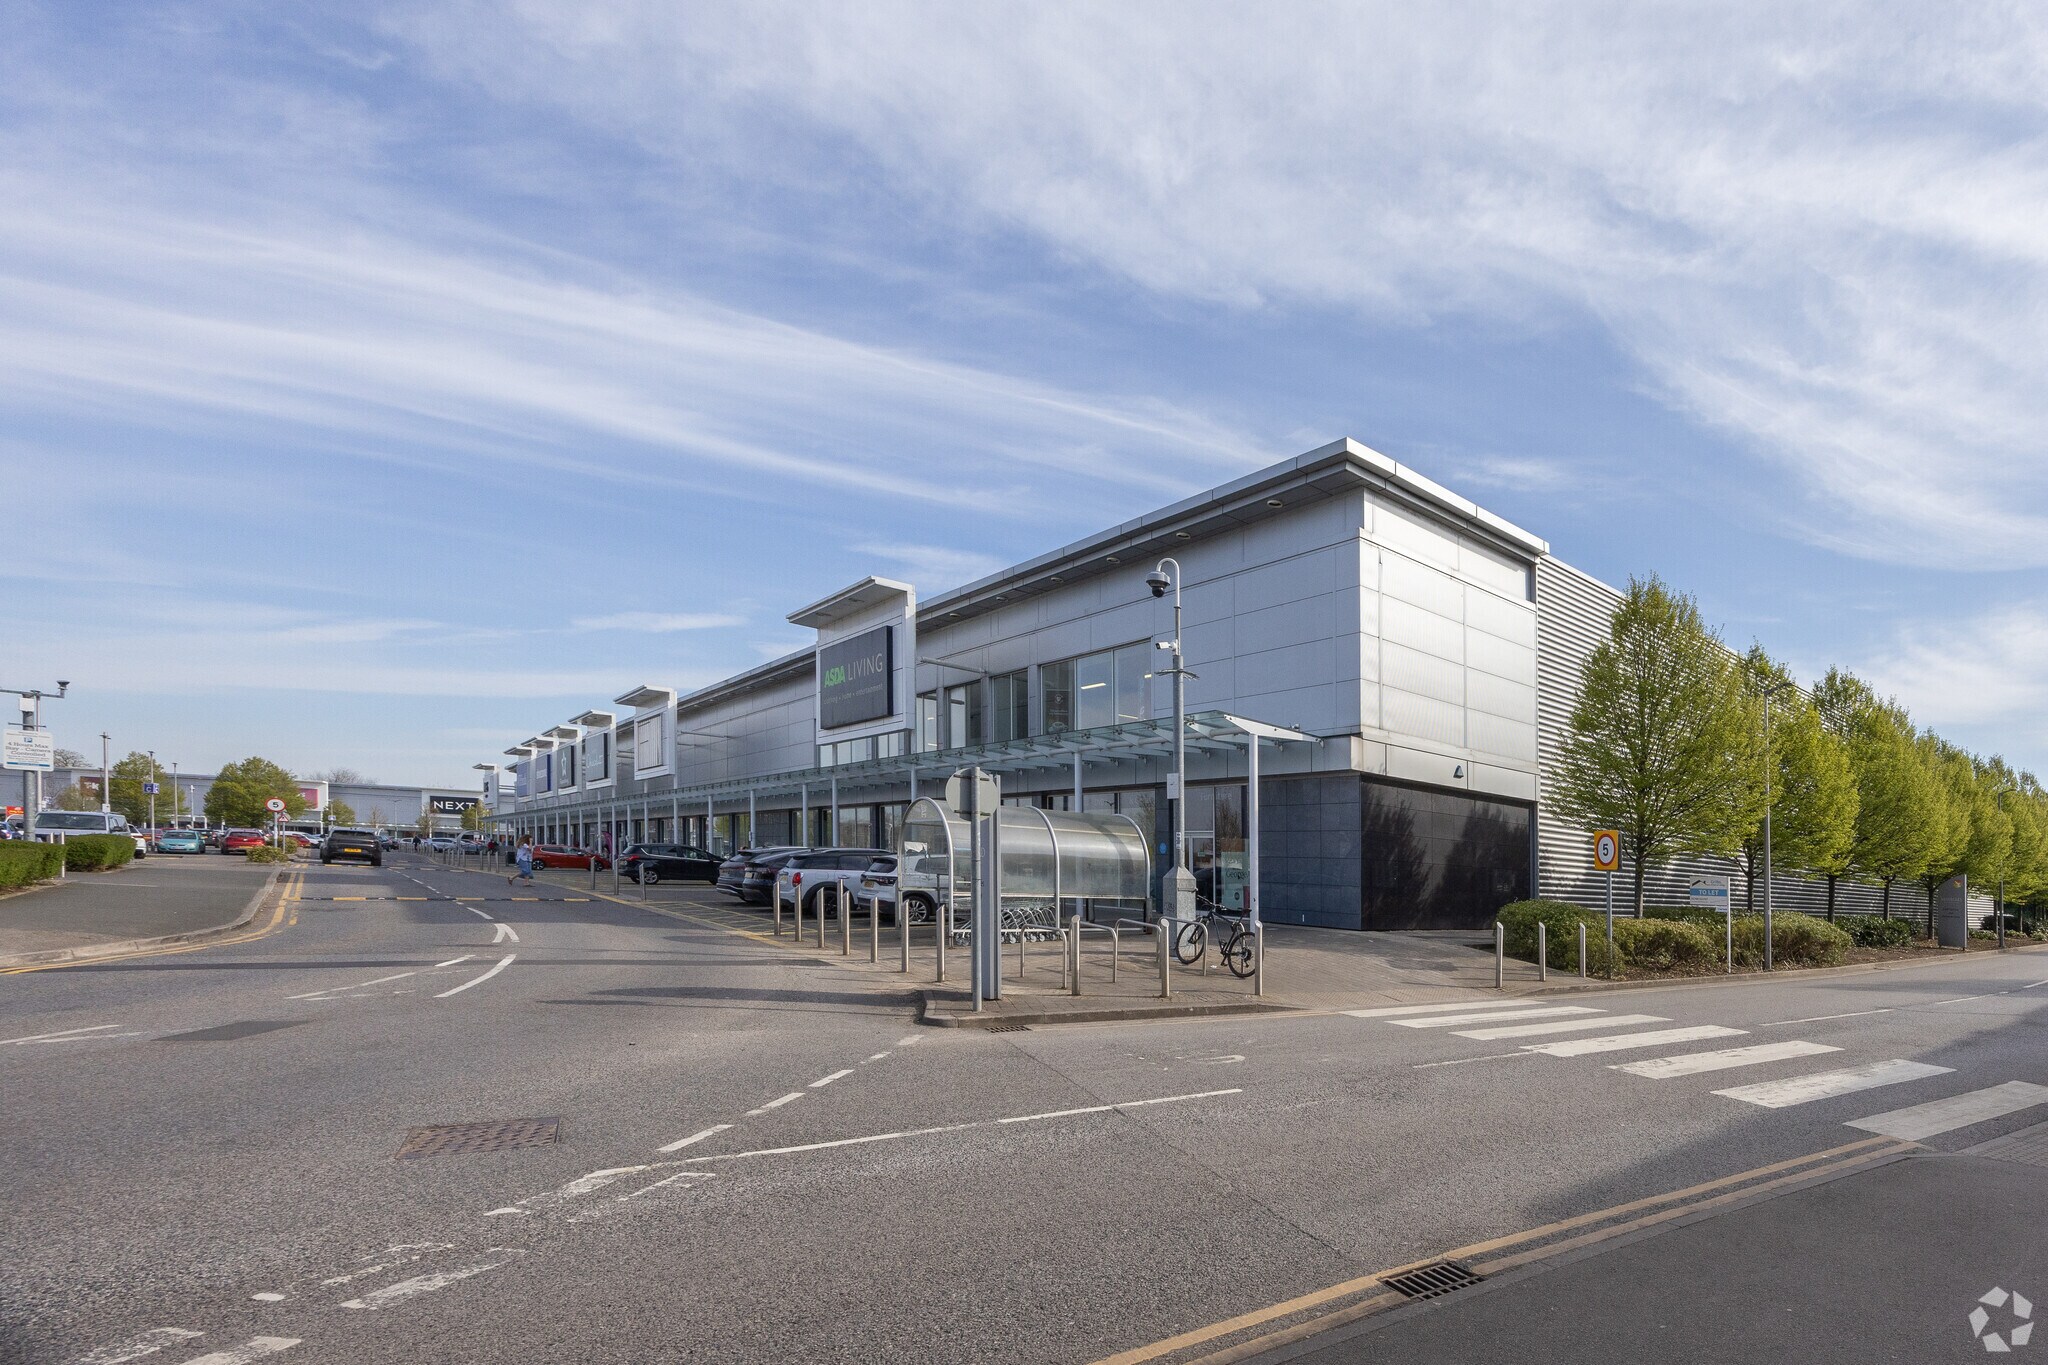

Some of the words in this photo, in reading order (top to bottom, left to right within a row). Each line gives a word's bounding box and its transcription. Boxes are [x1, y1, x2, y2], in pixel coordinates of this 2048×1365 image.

[824, 665, 846, 688] ASDA
[848, 653, 883, 681] LIVING
[433, 800, 475, 810] NEXT
[1602, 843, 1609, 856] 5
